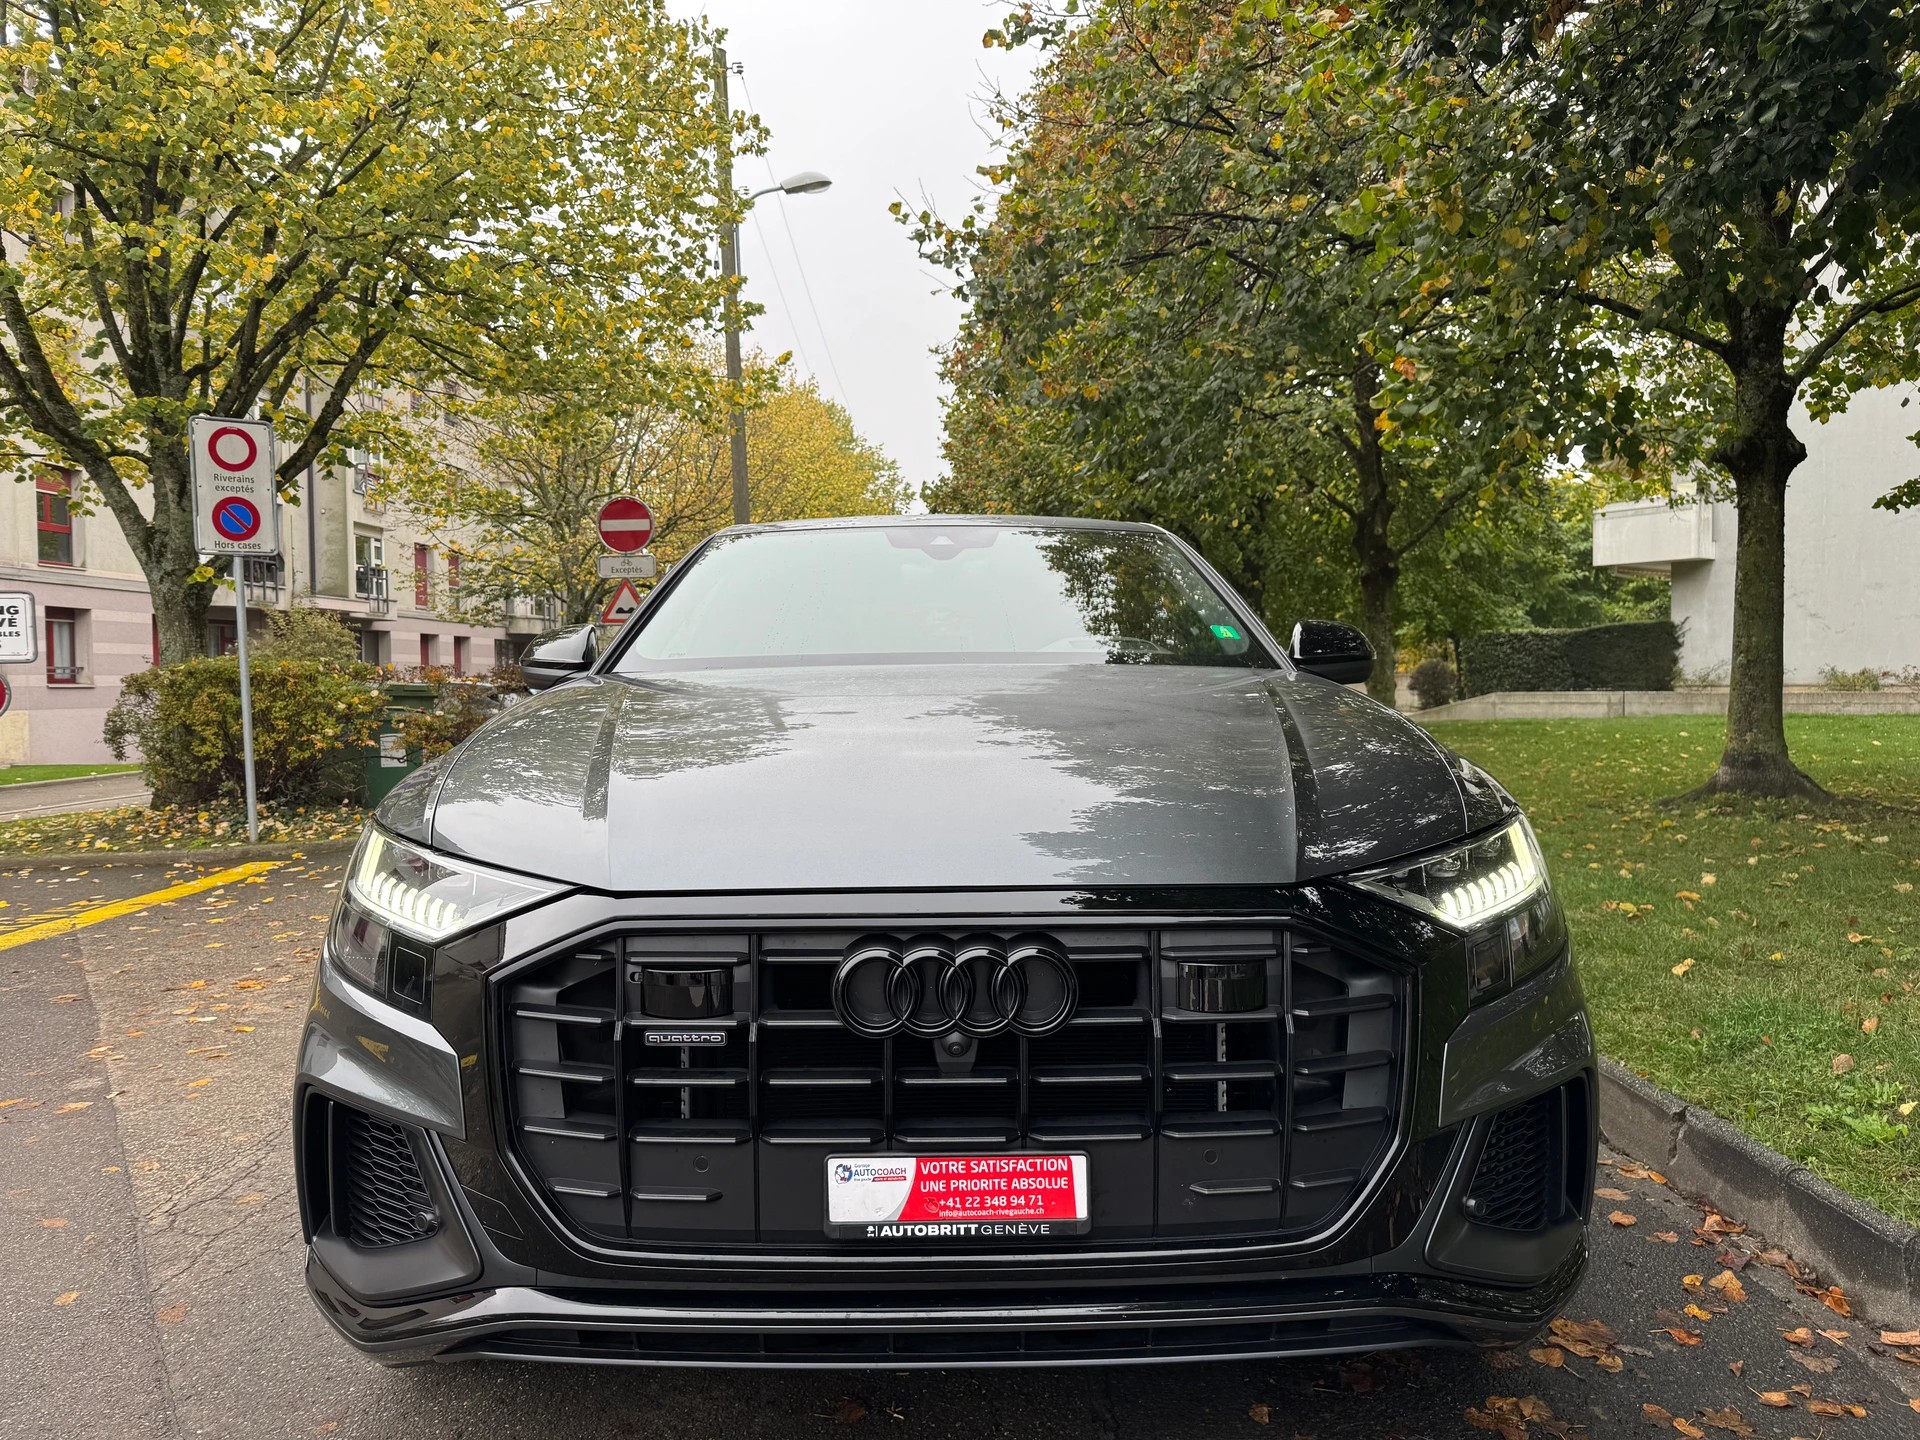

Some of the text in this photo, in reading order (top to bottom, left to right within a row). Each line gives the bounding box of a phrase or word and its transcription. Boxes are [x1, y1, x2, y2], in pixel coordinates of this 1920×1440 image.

[213, 473, 255, 484] Riverains
[215, 484, 255, 494] exceptés
[214, 541, 235, 549] Hors
[610, 566, 643, 575] Exceptés
[648, 1034, 722, 1043] quattro
[920, 1159, 1068, 1174] VOTRE SATISFACTION
[853, 1168, 907, 1176] AUTOCOACH
[920, 1177, 1069, 1192] UNE PRIORITE ABSOLUE
[939, 1195, 1044, 1208] +41 22 348 94 71
[938, 1208, 1045, 1218] info@autocoach-rivegauche.ch
[880, 1223, 1050, 1237] AUTOBRITT GENÈVE
